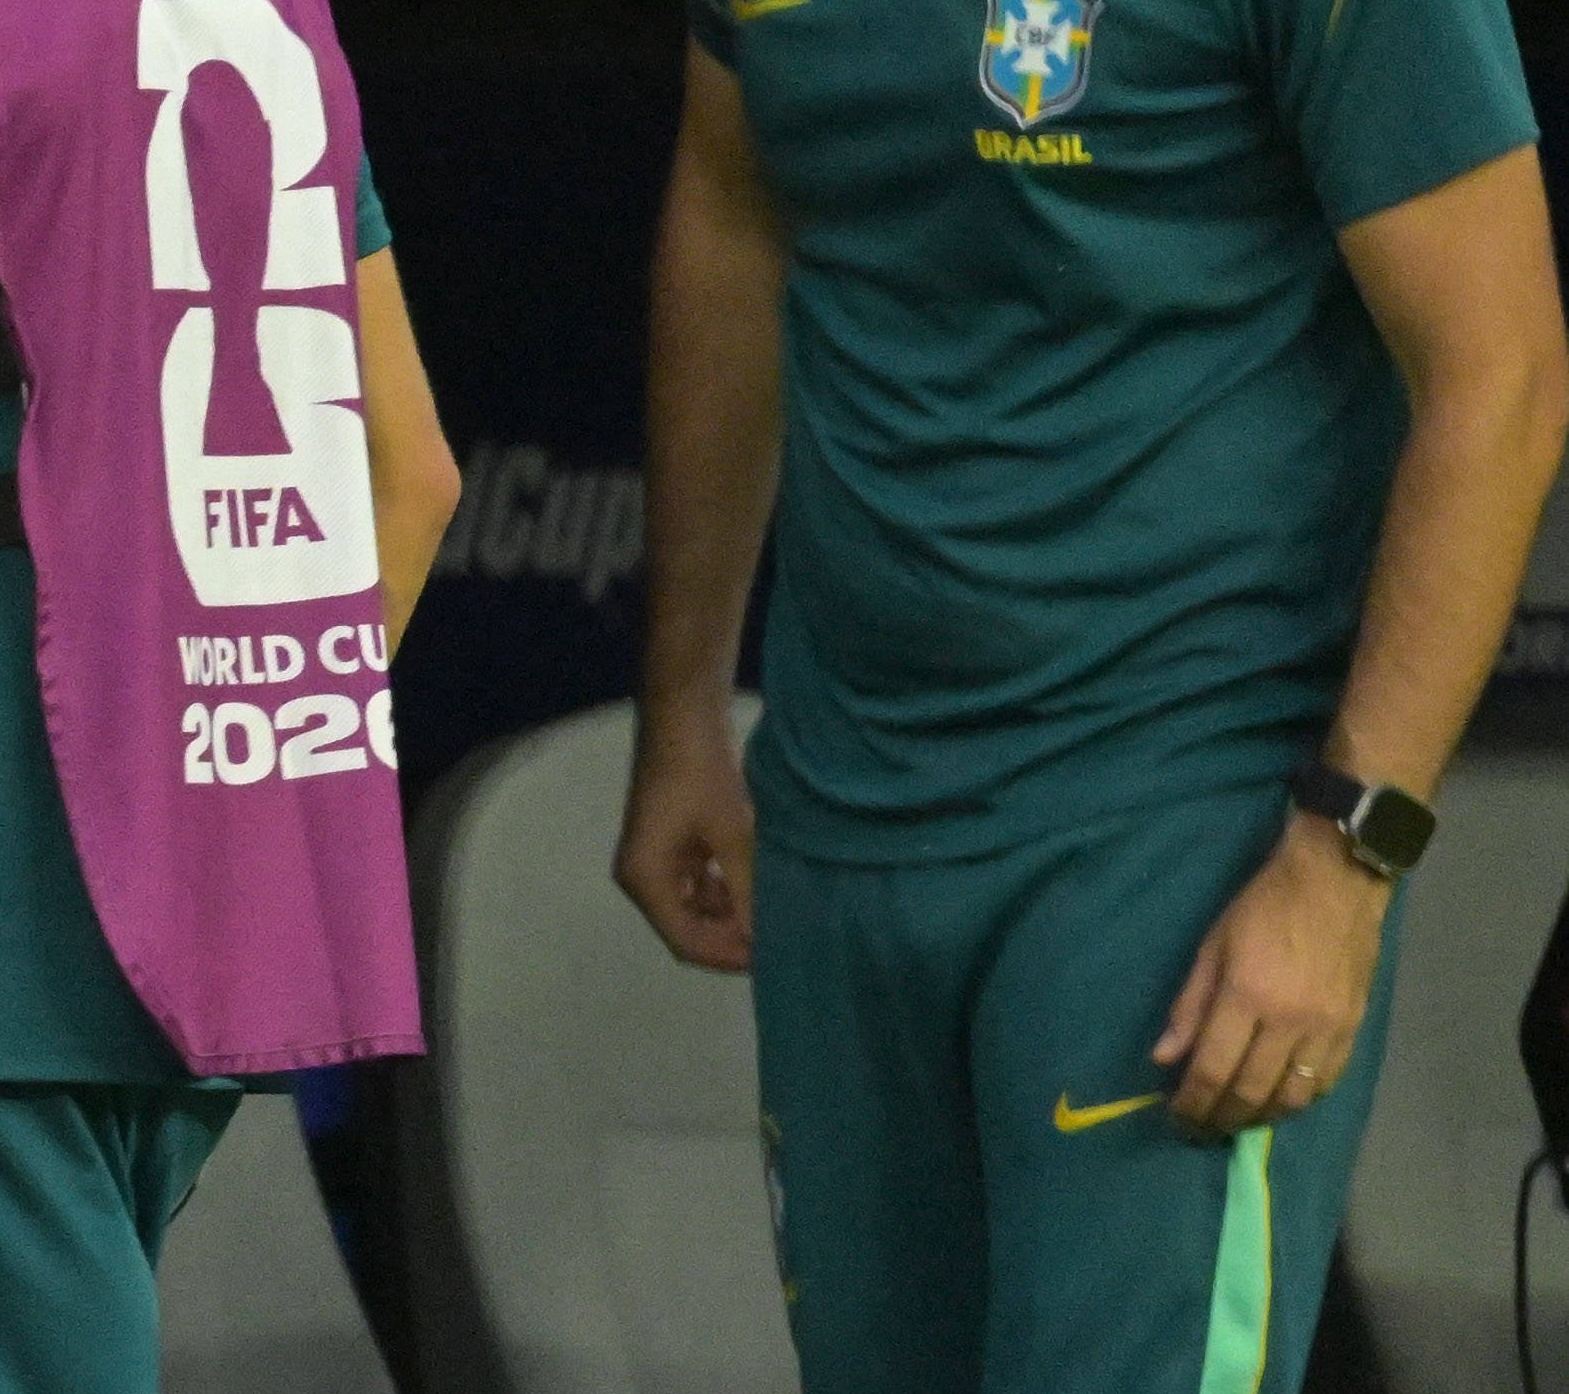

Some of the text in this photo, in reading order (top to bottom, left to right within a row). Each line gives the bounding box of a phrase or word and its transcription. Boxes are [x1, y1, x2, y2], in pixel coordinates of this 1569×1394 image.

[974, 128, 1093, 166] BRASIL
[203, 486, 328, 549] FIFA
[178, 623, 390, 687] WORLD CU
